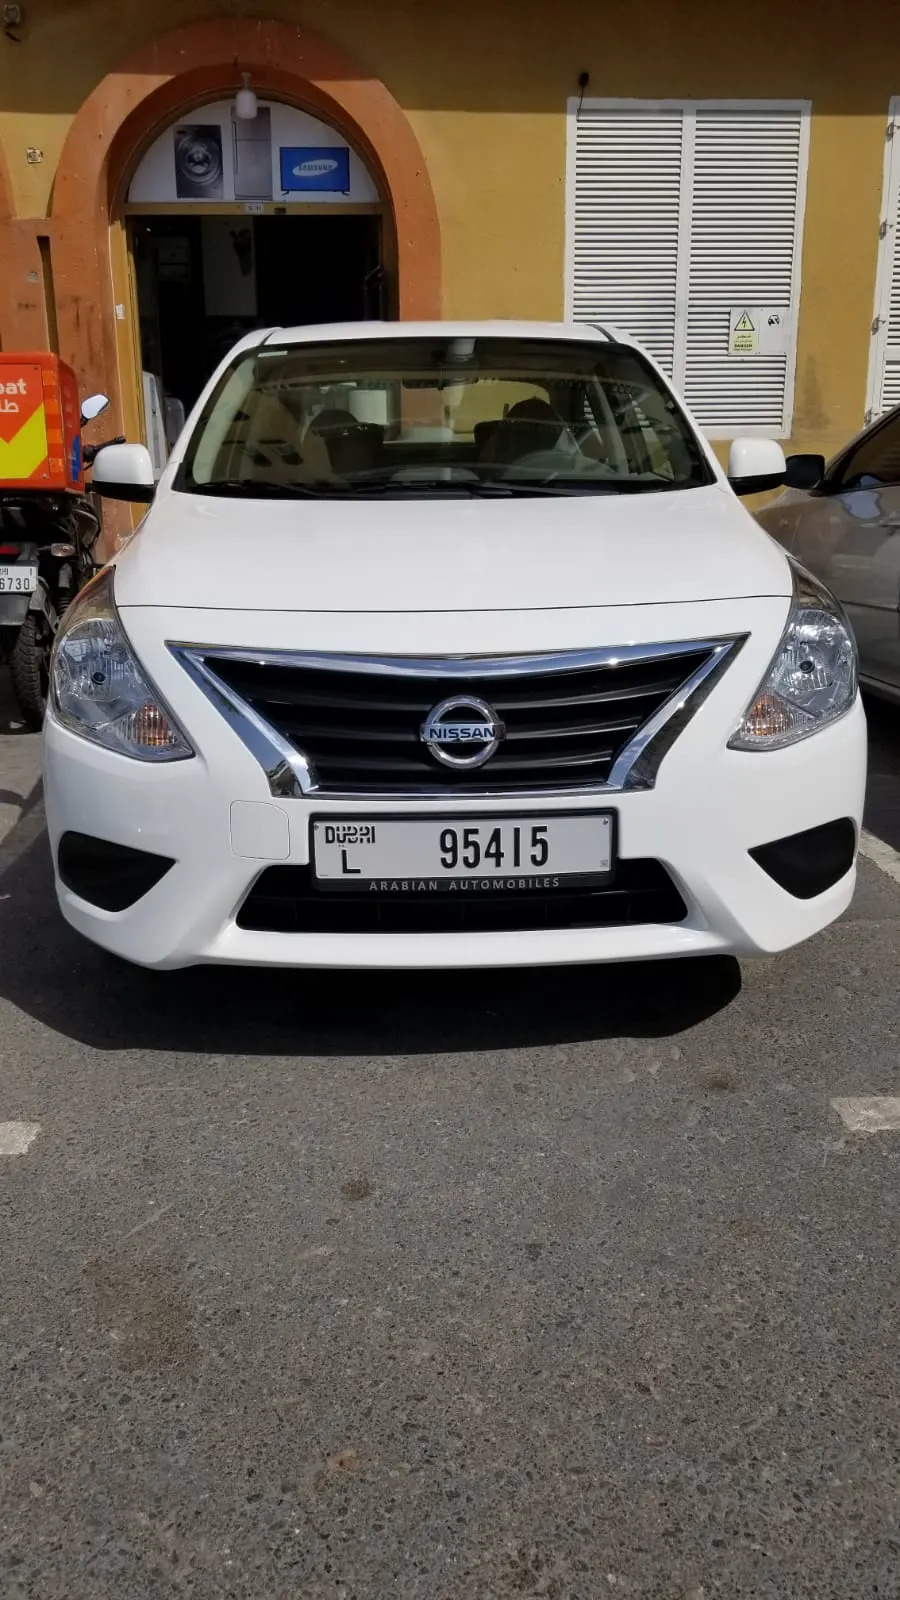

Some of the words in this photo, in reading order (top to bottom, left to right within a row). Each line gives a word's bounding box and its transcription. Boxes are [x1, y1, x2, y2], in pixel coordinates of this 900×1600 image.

[429, 727, 496, 739] NISSAN
[325, 825, 375, 844] DUBAI
[439, 825, 549, 869] 95415
[341, 849, 361, 874] L
[369, 880, 438, 891] ARABIAN
[449, 877, 560, 891] AUTOMOBILES
